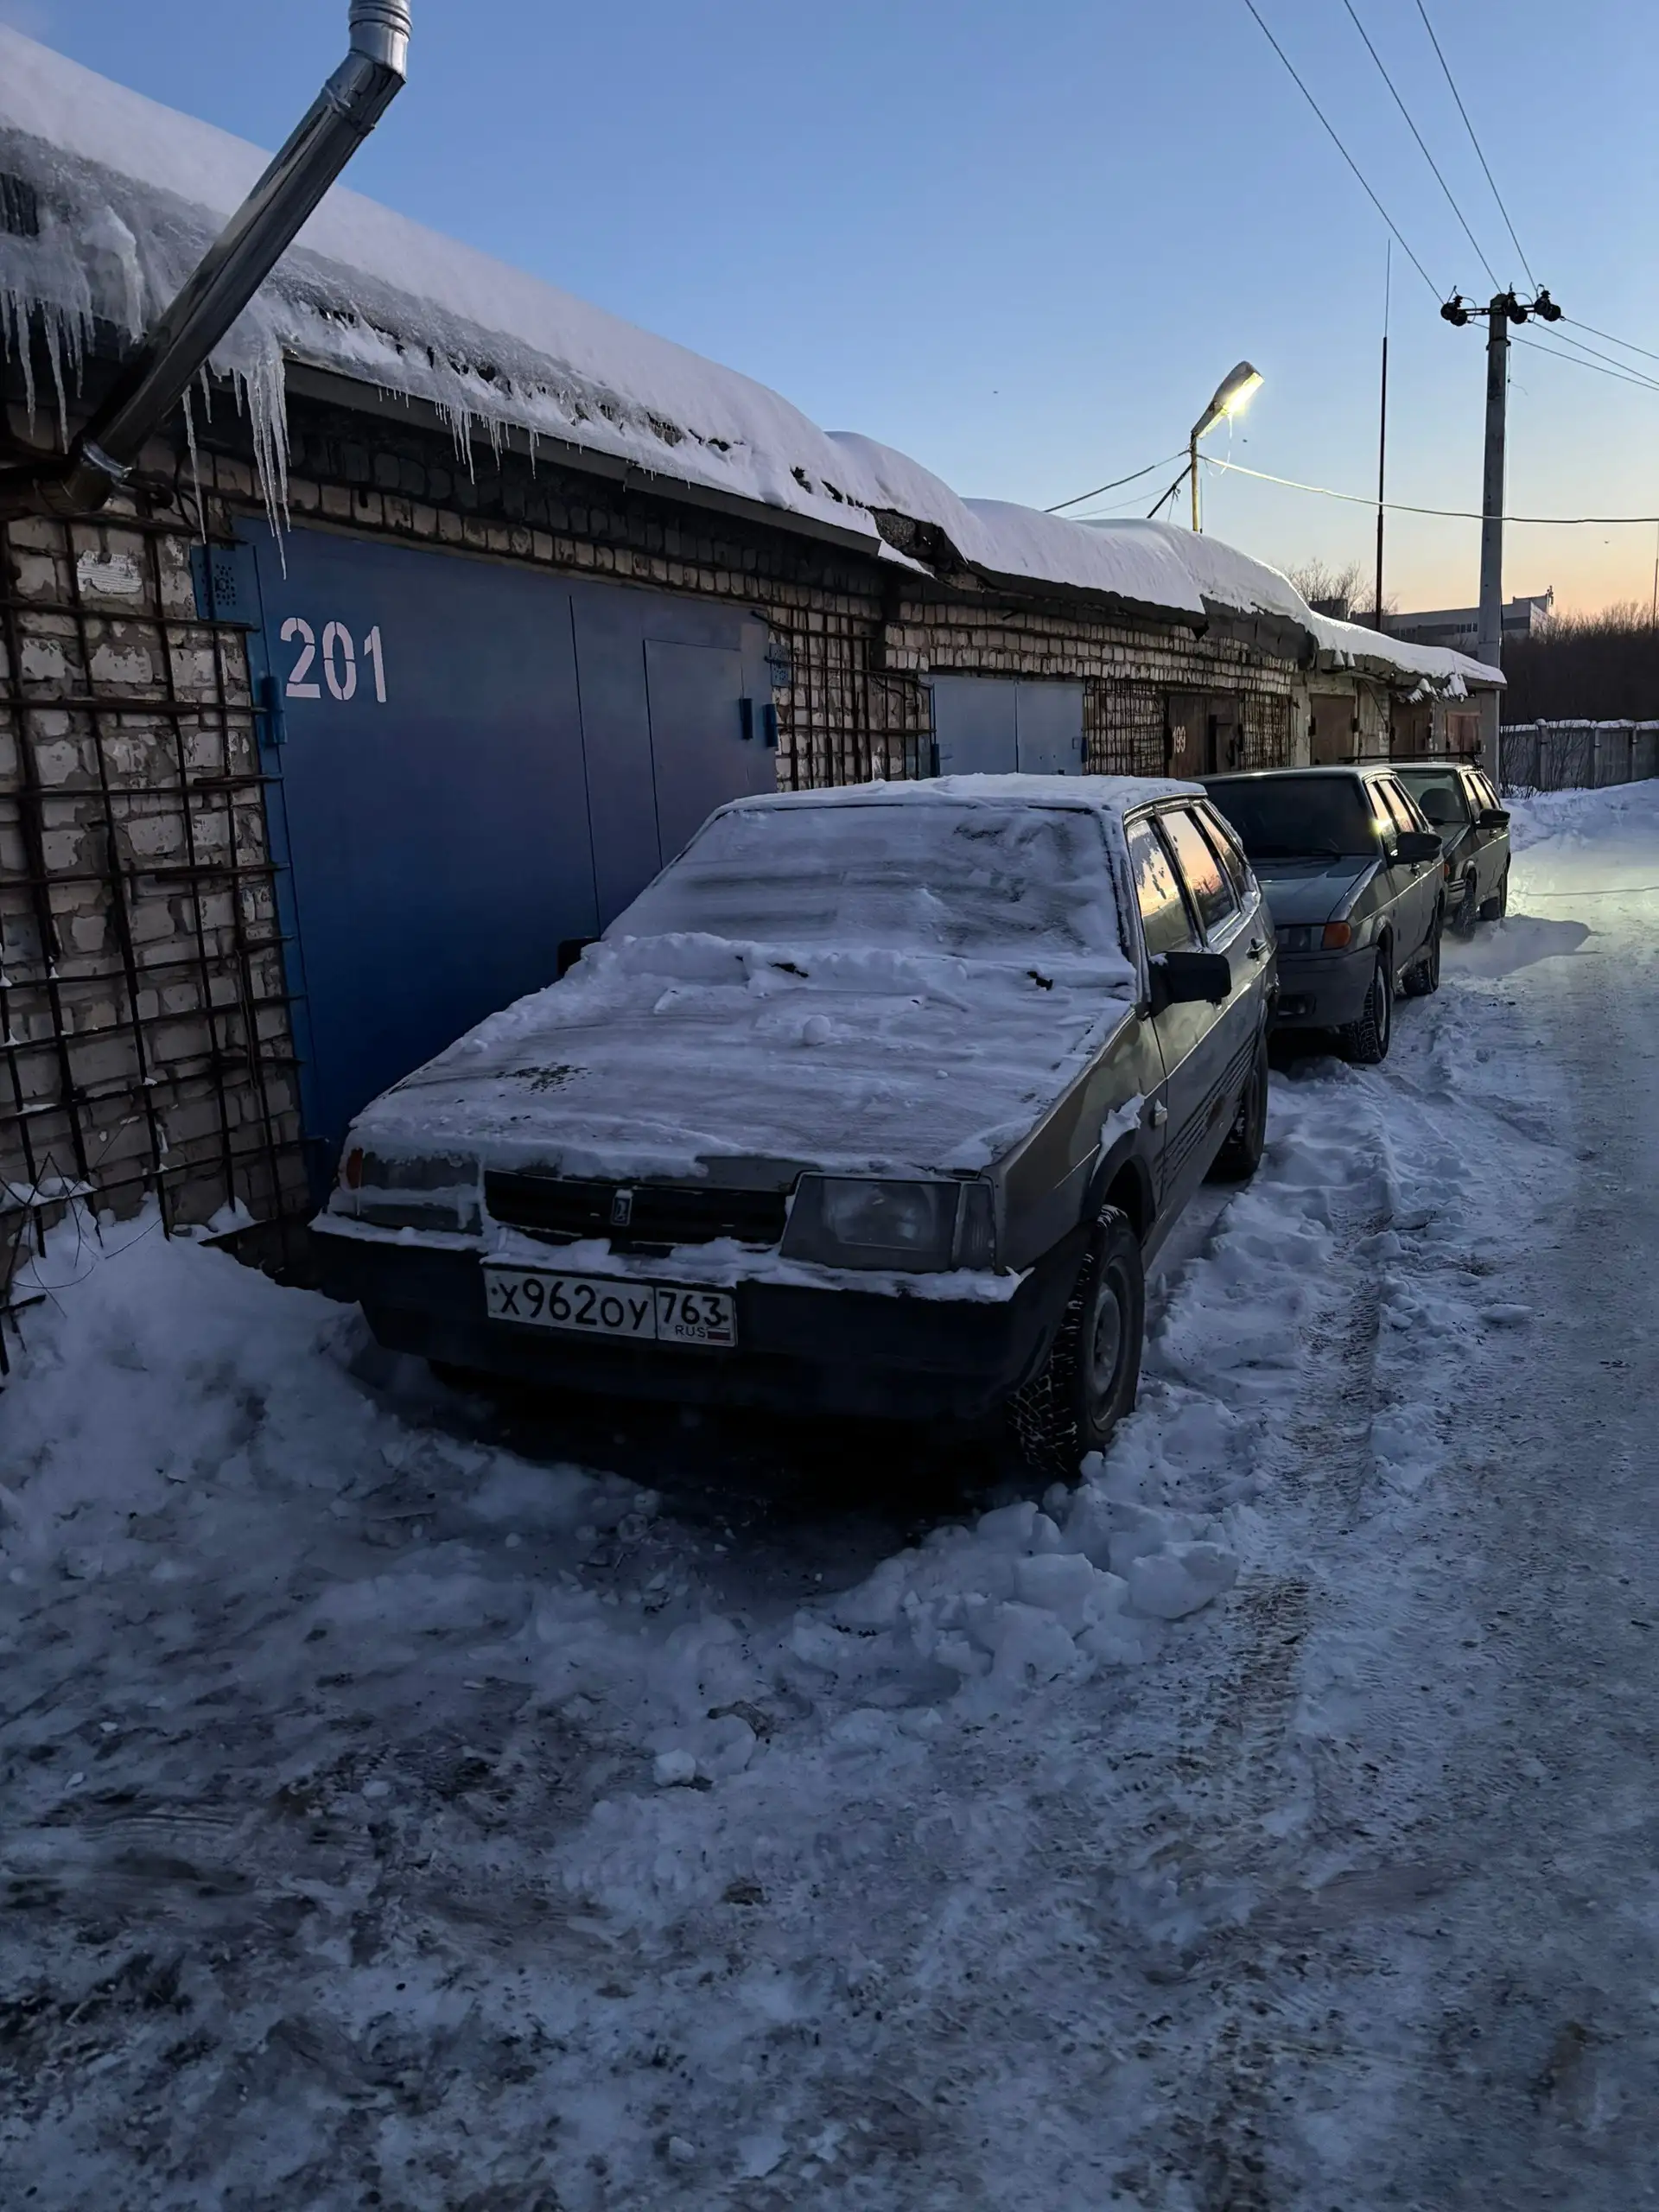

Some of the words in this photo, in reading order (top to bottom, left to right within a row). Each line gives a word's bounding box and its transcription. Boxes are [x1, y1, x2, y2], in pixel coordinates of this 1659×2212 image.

[280, 617, 386, 702] 201
[1172, 726, 1186, 753] 199
[658, 1291, 723, 1326] 763
[674, 1325, 707, 1338] RUS
